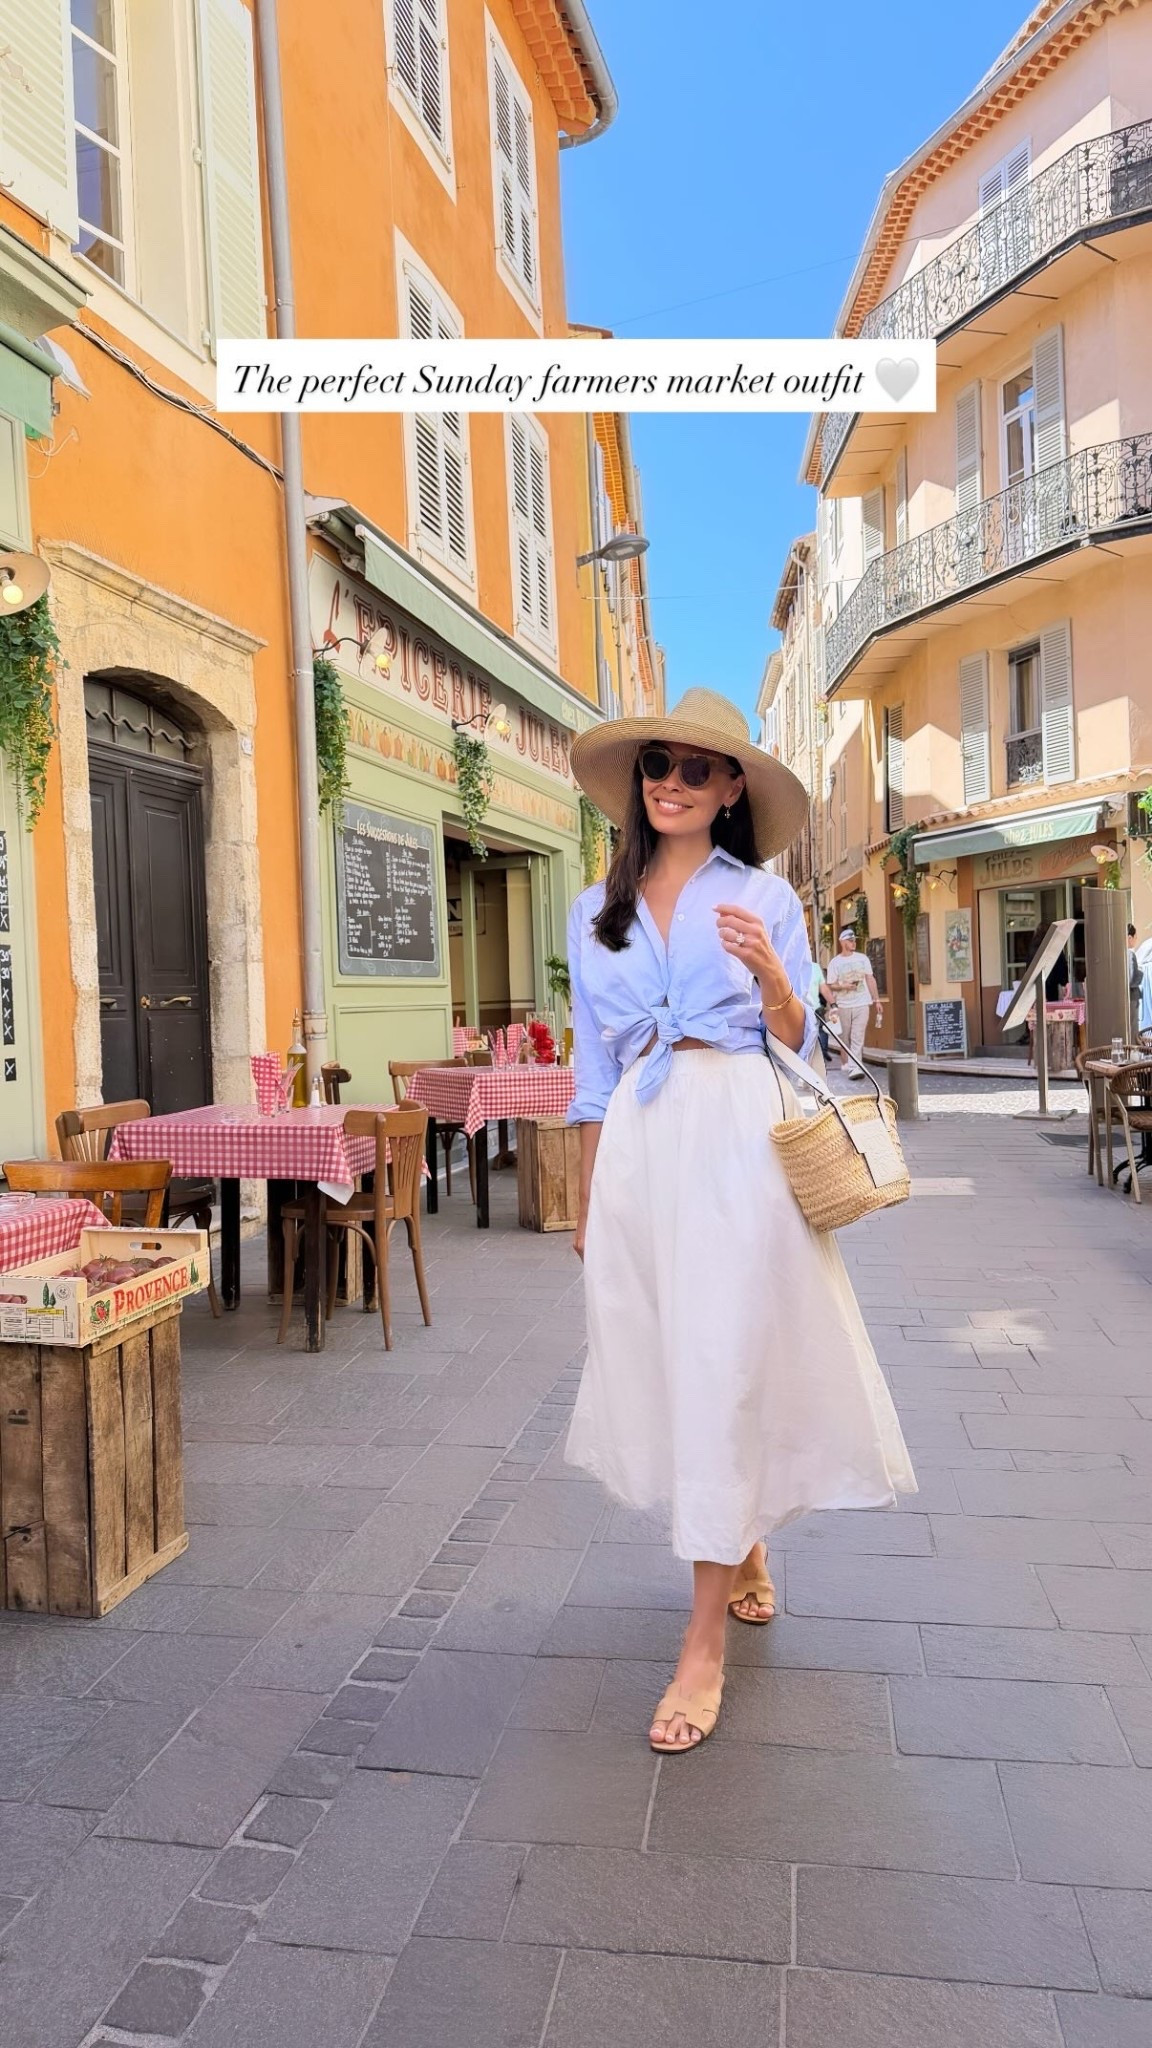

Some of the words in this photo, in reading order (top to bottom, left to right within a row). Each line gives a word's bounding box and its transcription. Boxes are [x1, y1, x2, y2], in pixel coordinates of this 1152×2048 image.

[515, 706, 570, 779] JULES
[979, 856, 1034, 885] JULES
[113, 1266, 188, 1319] PROVENCE
